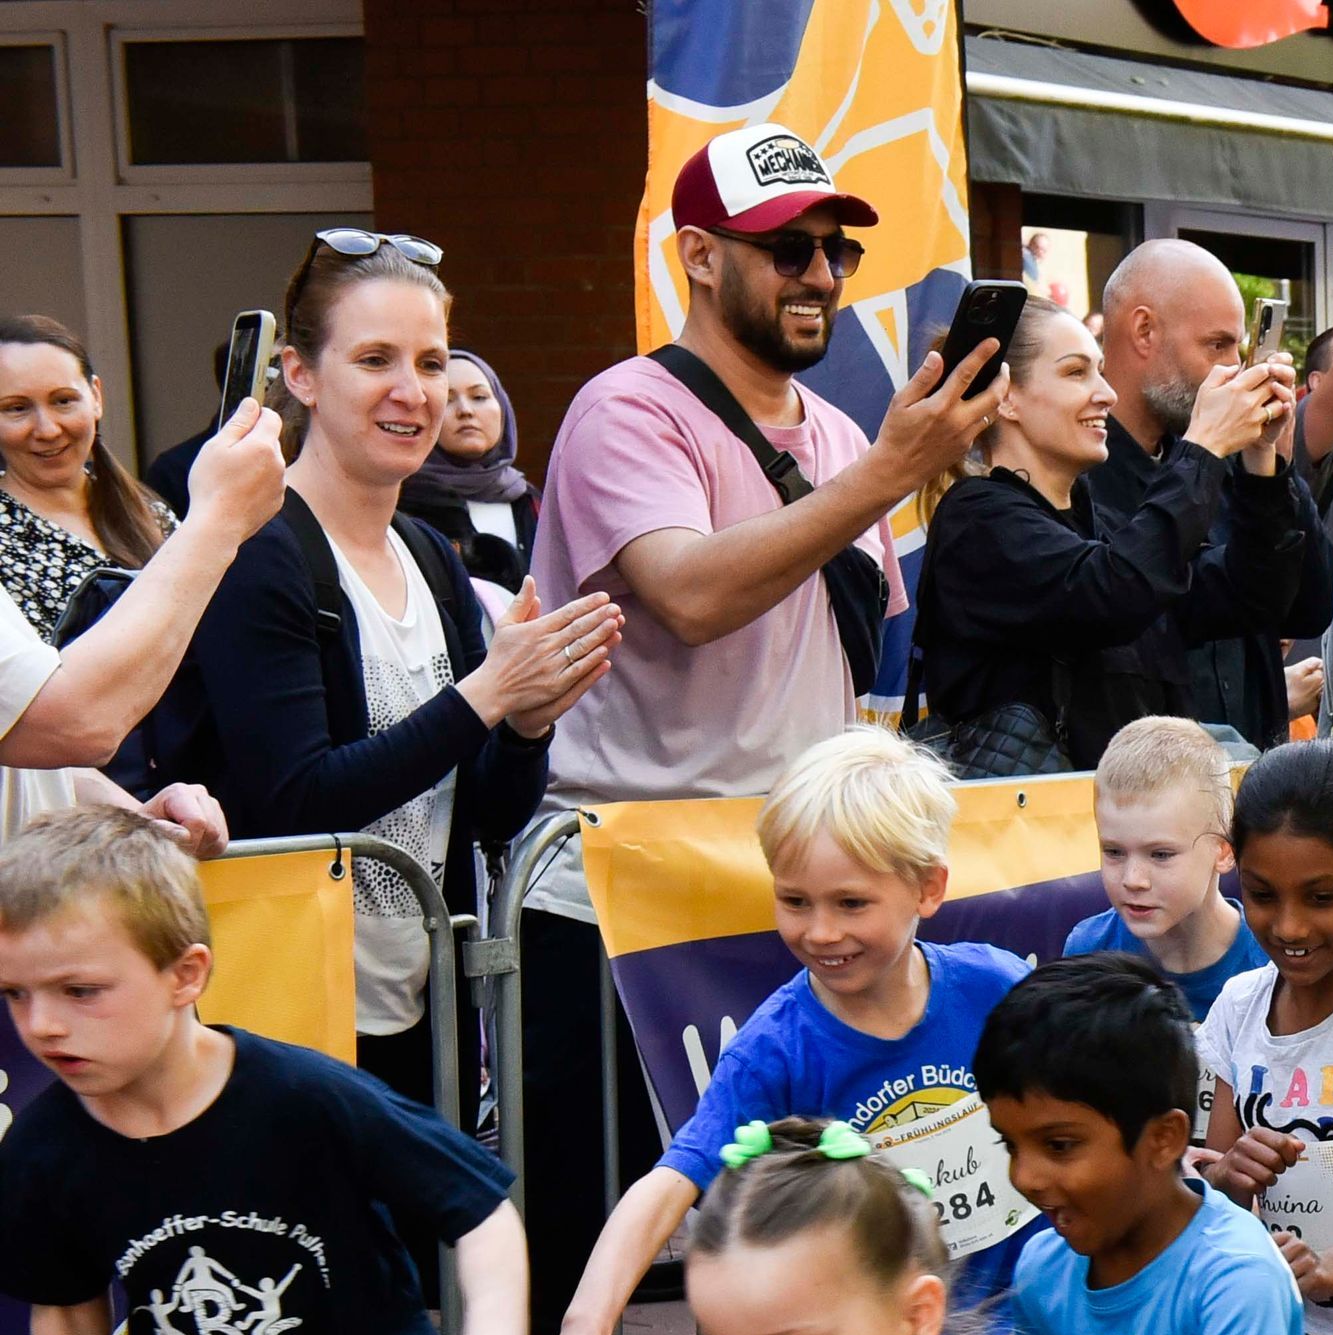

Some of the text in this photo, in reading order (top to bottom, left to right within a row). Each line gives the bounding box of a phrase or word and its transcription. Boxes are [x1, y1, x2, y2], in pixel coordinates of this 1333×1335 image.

[921, 1064, 979, 1090] Büdc
[931, 1146, 982, 1189] kub
[1260, 1193, 1324, 1214] hvina
